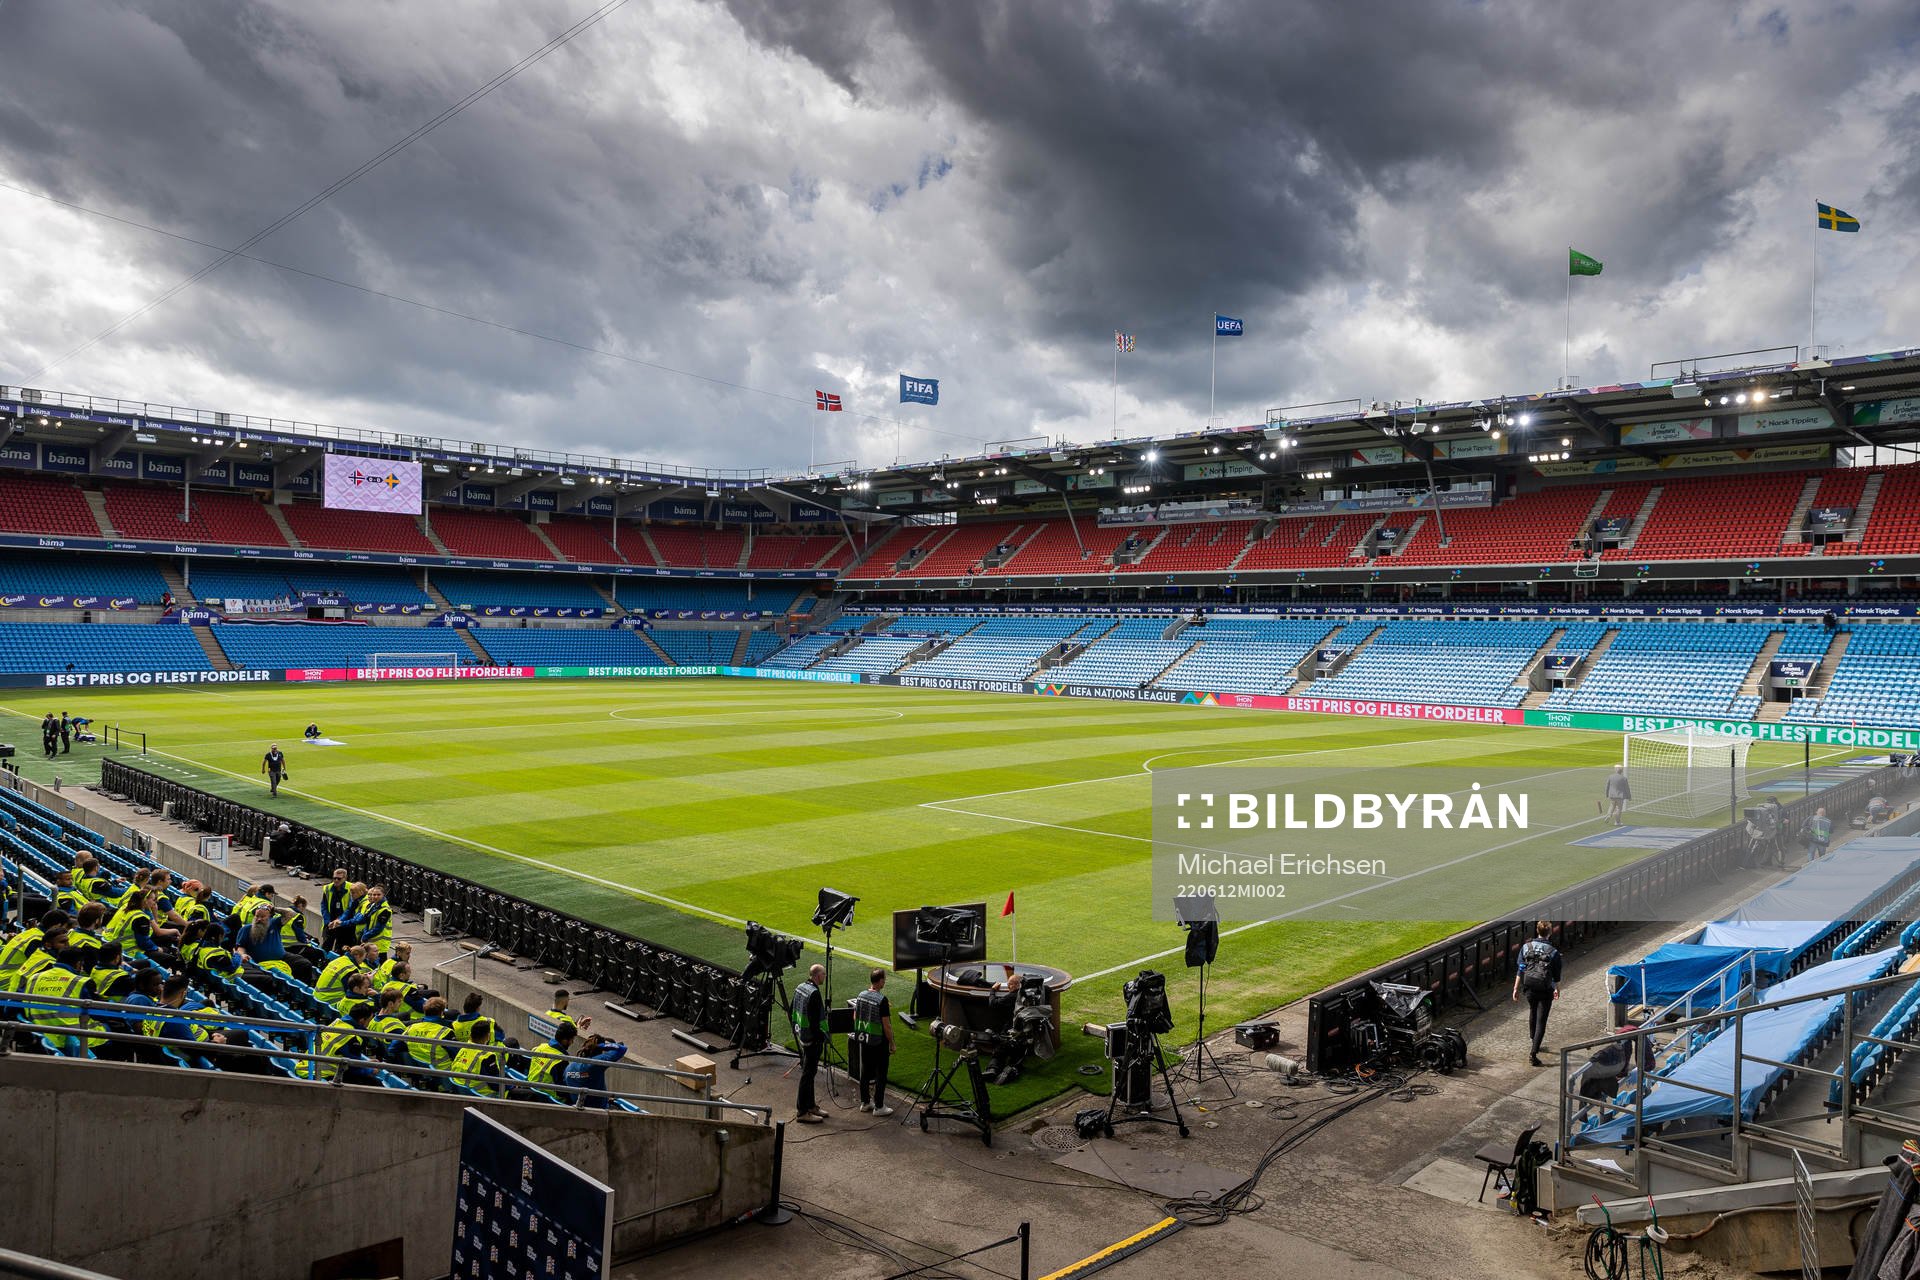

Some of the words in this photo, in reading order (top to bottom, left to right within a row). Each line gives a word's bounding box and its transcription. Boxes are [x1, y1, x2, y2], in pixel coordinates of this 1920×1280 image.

[1218, 321, 1240, 329] UEFA
[906, 381, 933, 394] FIFA
[1768, 418, 1790, 426] Norsk
[1790, 416, 1818, 426] Tipping
[0, 449, 31, 461] ama
[48, 452, 85, 466] bama
[105, 458, 133, 470] ama
[148, 462, 182, 474] bama
[1229, 464, 1252, 474] Tipping
[240, 470, 270, 482] bama
[467, 490, 490, 501] bama
[532, 496, 554, 506] bama
[591, 502, 611, 511] bama
[674, 505, 696, 515] bama
[725, 508, 747, 517] bama
[40, 538, 64, 547] bama
[182, 610, 209, 618] bama
[444, 614, 465, 623] bama
[358, 668, 385, 679] BEST
[388, 668, 413, 678] PRIS
[416, 668, 434, 678] OG
[437, 668, 467, 678] FLEST
[470, 667, 523, 677] FORDELER
[589, 667, 610, 676] BEST
[612, 667, 631, 676] PRIS
[633, 667, 647, 675] OG
[649, 666, 673, 675] FLEST
[675, 666, 716, 675] FORDELER
[756, 669, 770, 677] BEST
[772, 670, 784, 679] PRIS
[786, 670, 797, 679] OG
[797, 671, 815, 681] FLEST
[817, 672, 851, 682] FORDELER
[46, 674, 86, 686] BEST
[90, 674, 123, 685] PRIS
[127, 673, 151, 684] OG
[155, 672, 197, 683] FLEST
[200, 670, 270, 682] FORDELER
[900, 677, 919, 686] BEST
[920, 678, 937, 688] PRIS
[939, 679, 951, 689] OG
[953, 680, 977, 691] FLEST
[979, 681, 1023, 693] FORDELER
[1070, 686, 1092, 697] UEFA
[1094, 687, 1135, 700] NATIONS
[1138, 689, 1176, 702] LEAGUE
[1234, 695, 1254, 703] THON
[1288, 698, 1319, 712] BEST
[1323, 700, 1351, 713] PRIS
[1354, 702, 1376, 715] OG
[1380, 703, 1419, 717] FLEST
[1425, 706, 1503, 723] FORDELER
[1546, 713, 1574, 722] THON
[1623, 716, 1669, 732] BEST
[1721, 721, 1752, 738] OG
[1759, 724, 1822, 742] FLEST
[1826, 727, 1920, 749] FORDEL
[858, 1032, 869, 1043] 61
